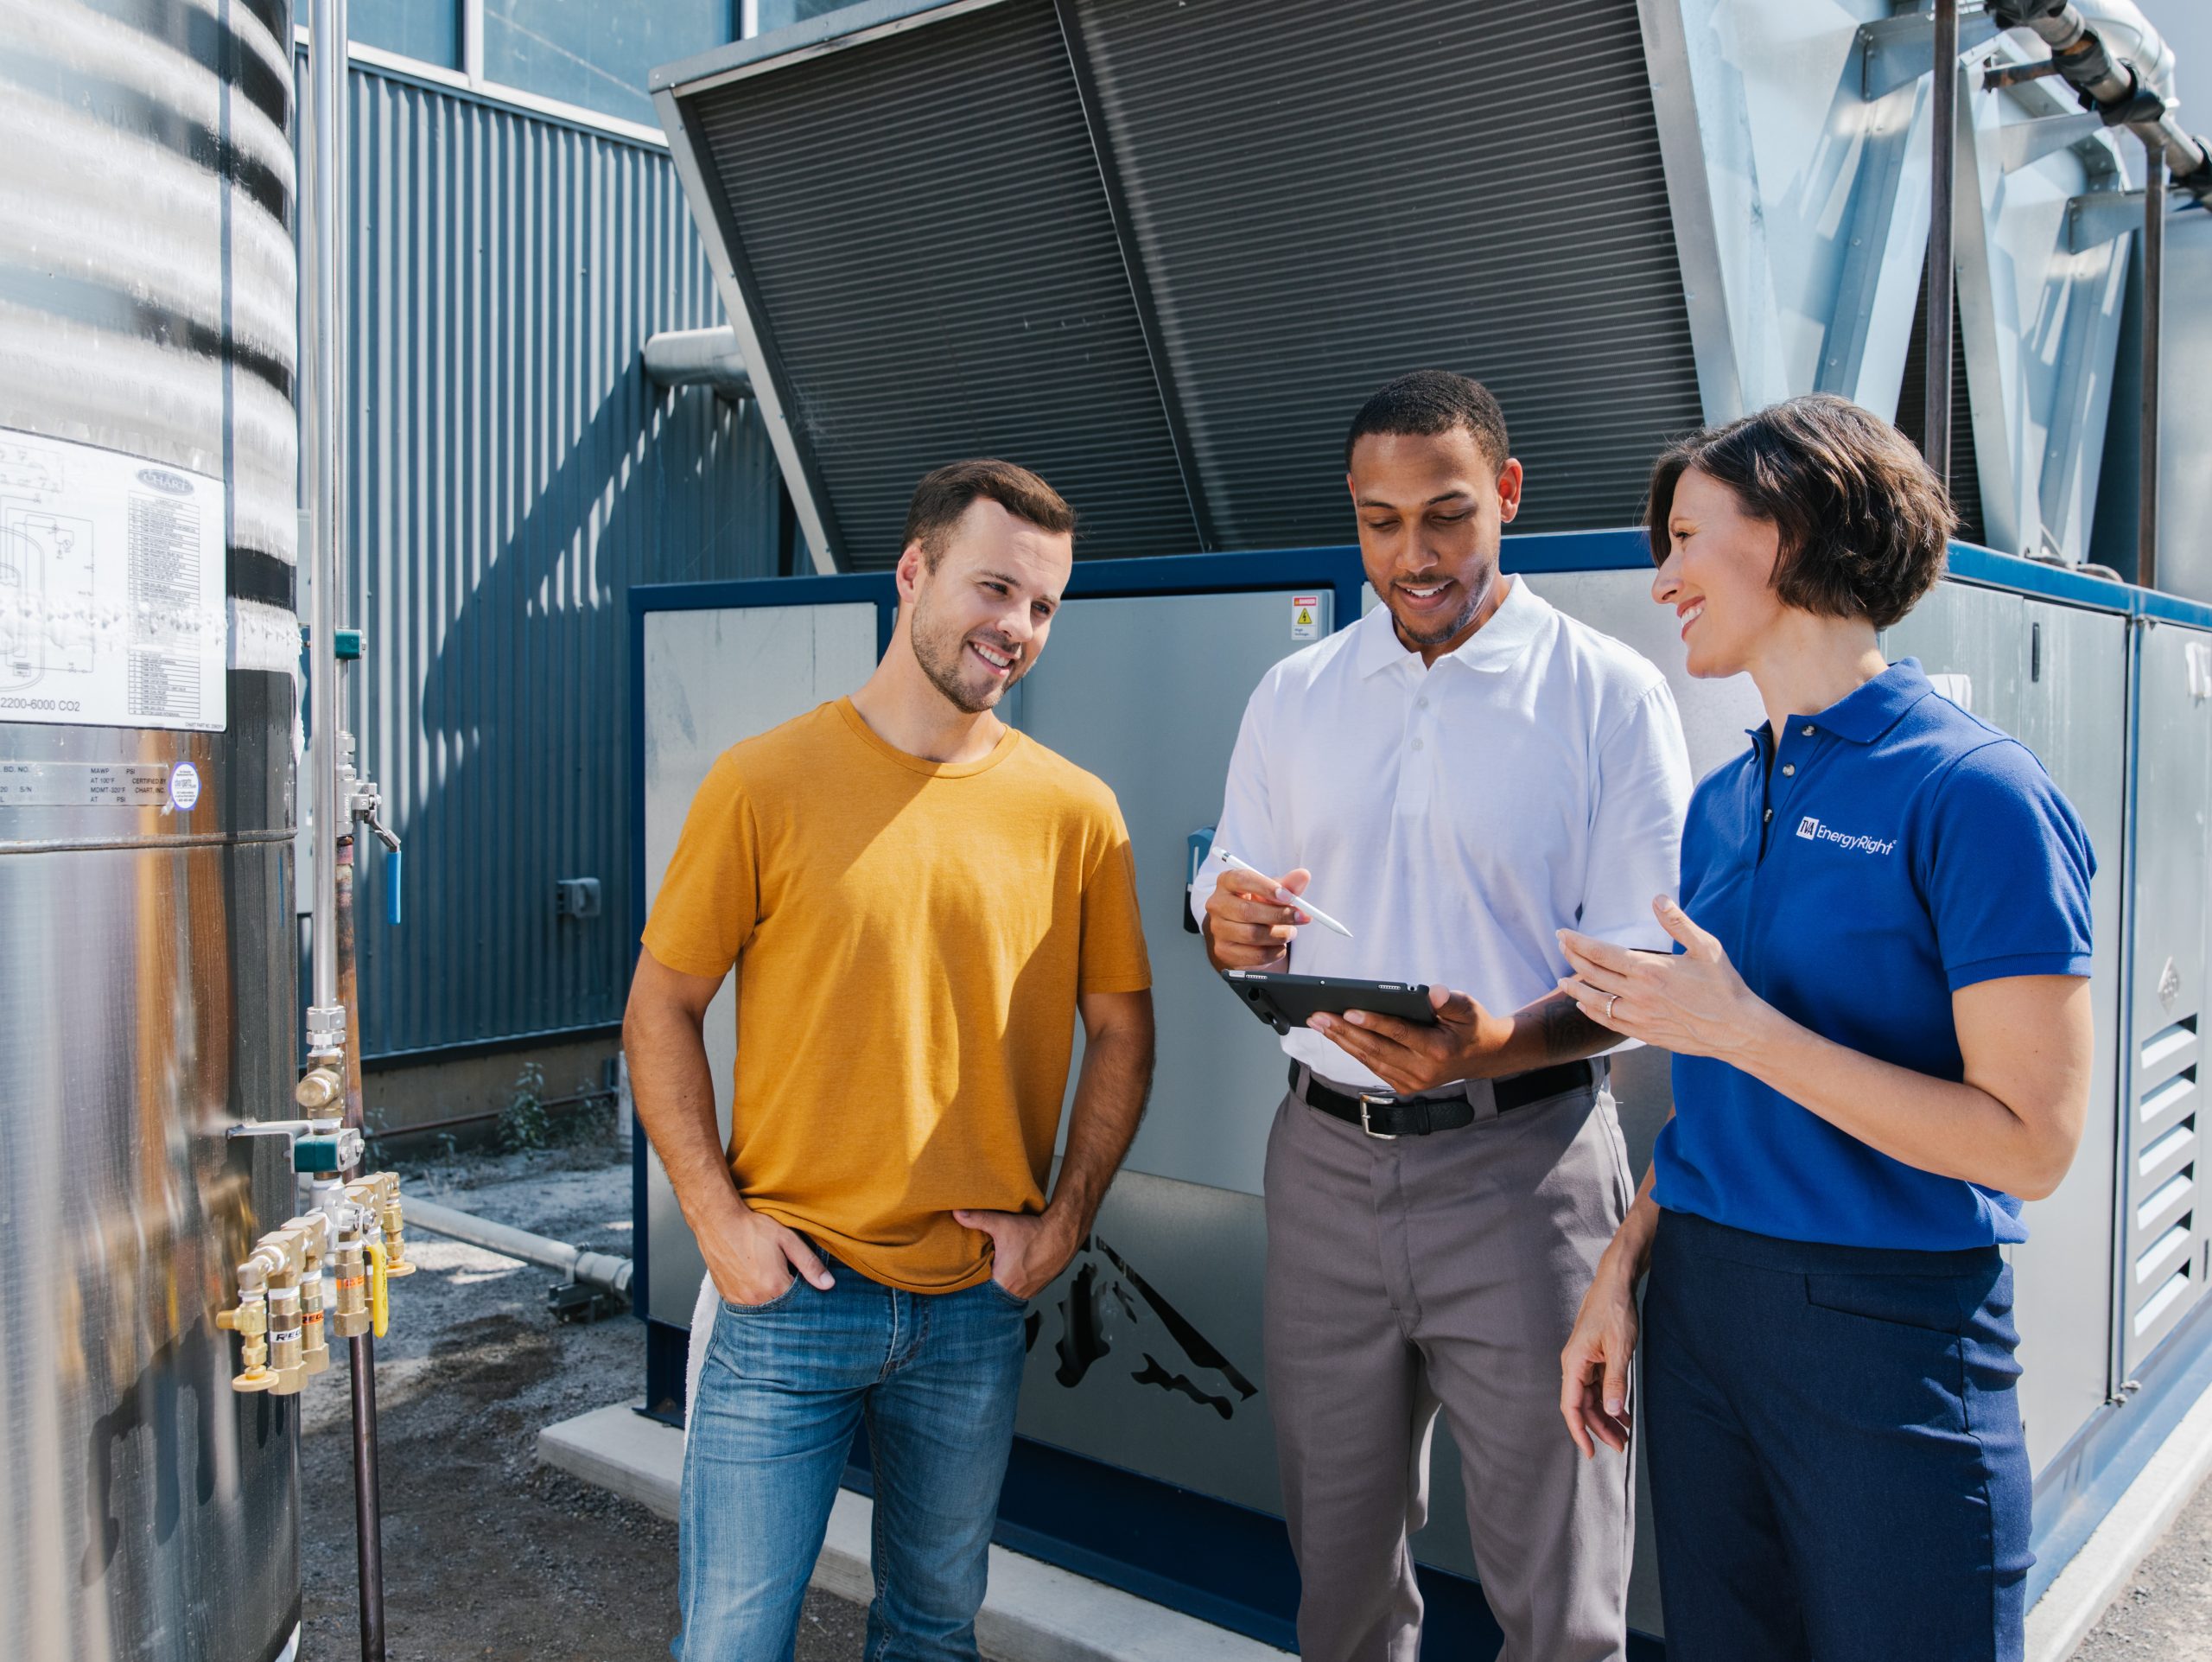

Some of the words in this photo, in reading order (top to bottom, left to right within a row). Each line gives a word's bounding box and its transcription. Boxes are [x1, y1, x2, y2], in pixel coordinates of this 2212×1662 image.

[143, 472, 188, 492] CHART
[0, 697, 55, 710] 2200-6000
[59, 700, 80, 712] CO2
[1800, 820, 1815, 836] TVA
[1817, 825, 1893, 855] EnergyRight
